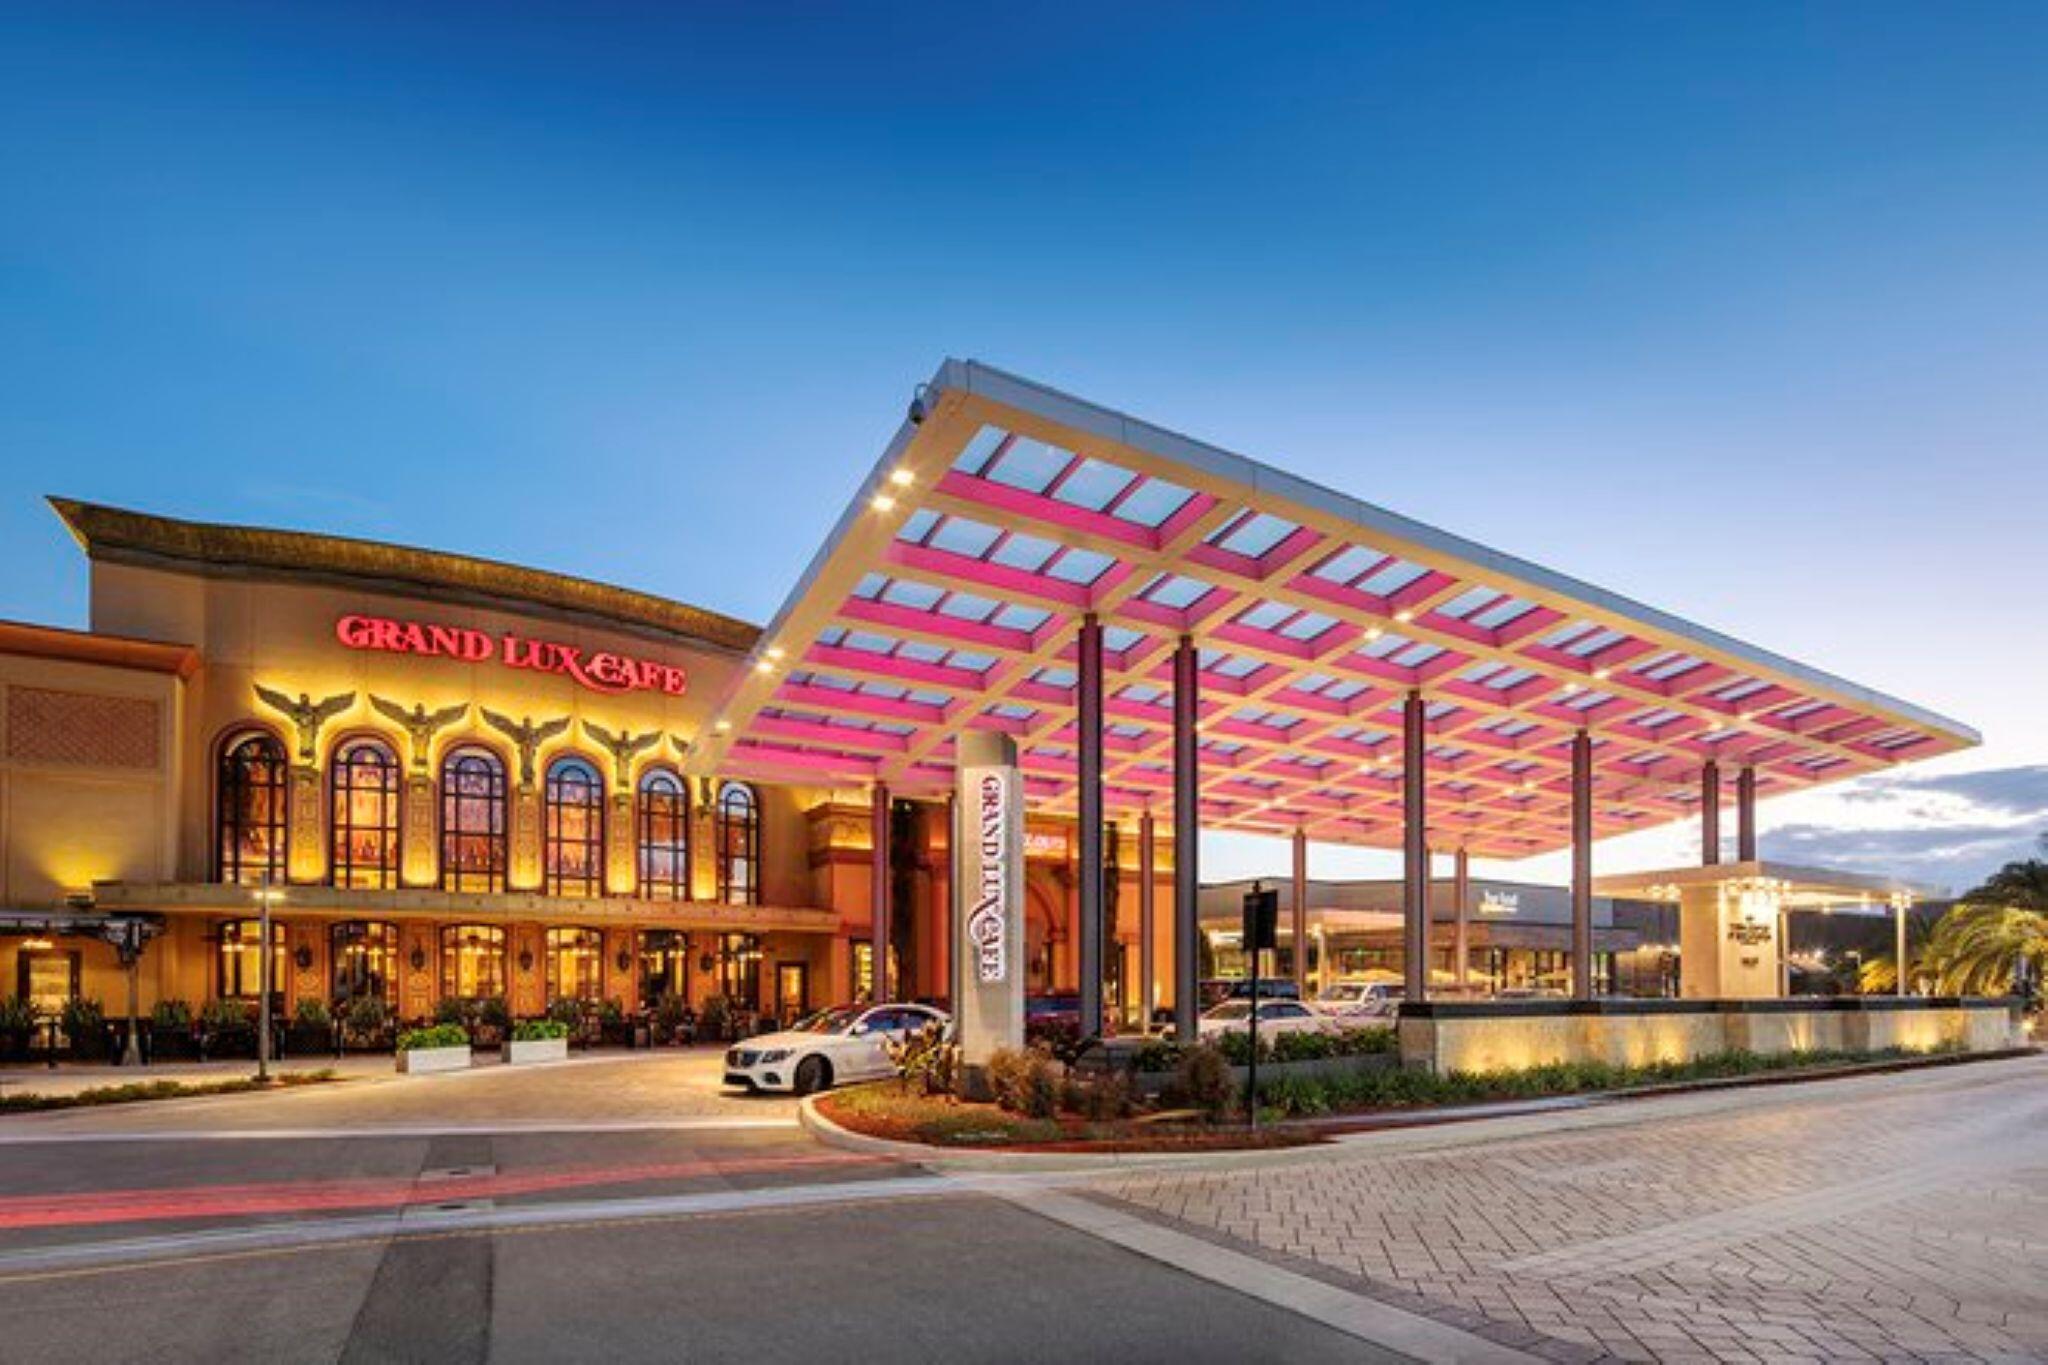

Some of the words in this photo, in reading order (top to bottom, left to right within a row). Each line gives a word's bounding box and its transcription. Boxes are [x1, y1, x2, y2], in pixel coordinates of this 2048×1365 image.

[336, 615, 494, 662] GRAND
[584, 652, 685, 694] CAFE
[981, 775, 1001, 857] GRAND
[981, 912, 1001, 978] CAFE
